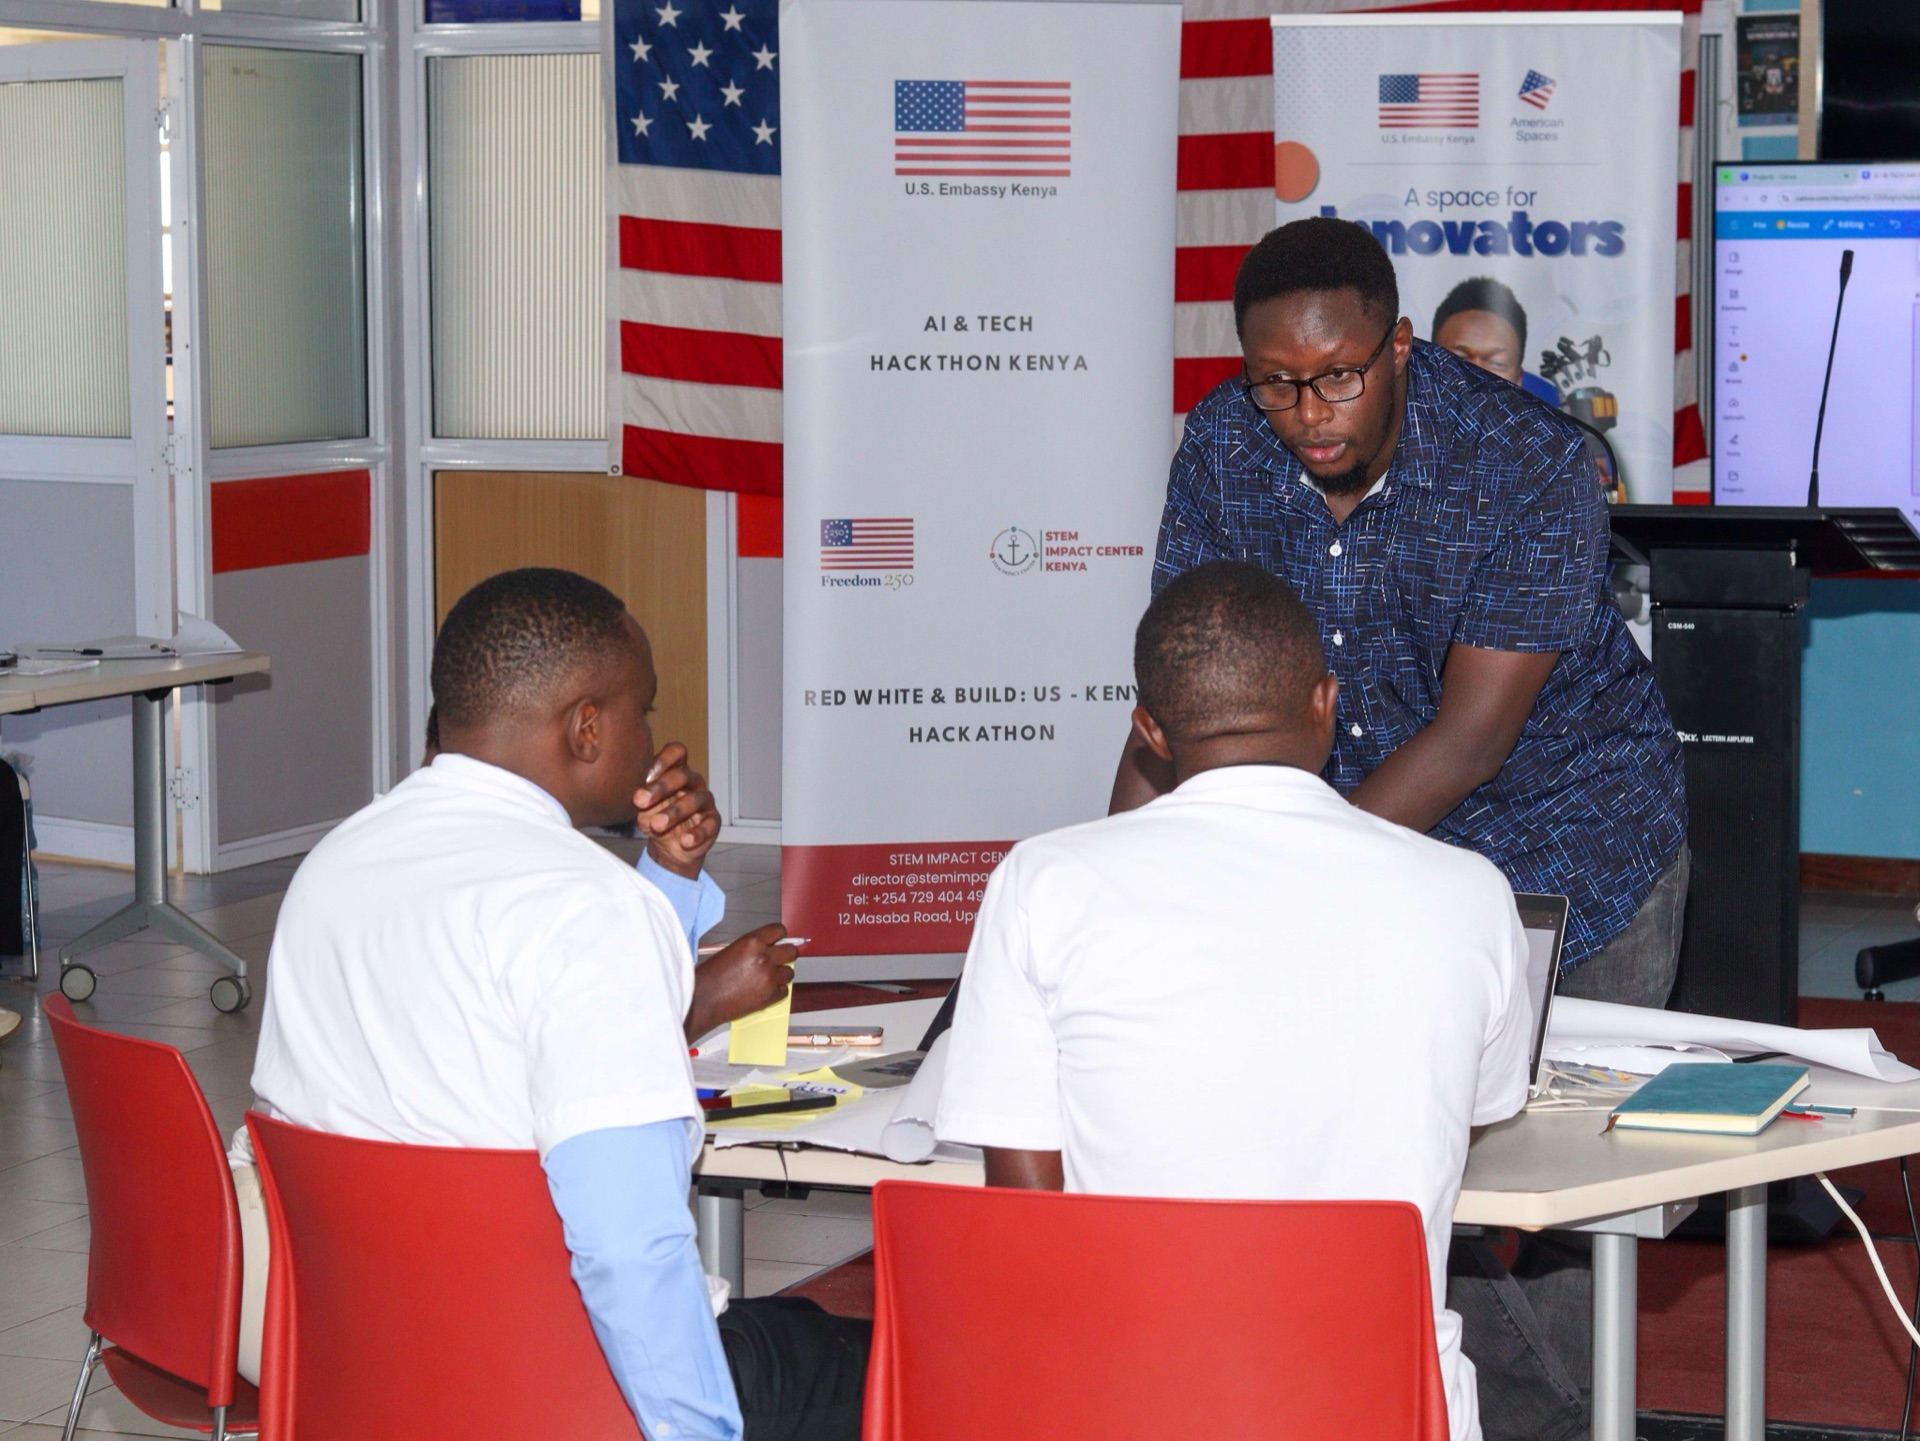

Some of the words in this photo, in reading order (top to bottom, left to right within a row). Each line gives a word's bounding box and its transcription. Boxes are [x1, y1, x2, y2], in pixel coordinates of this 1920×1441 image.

[1510, 116, 1565, 129] American
[1447, 134, 1476, 146] Kenya
[1516, 130, 1559, 143] Spaces
[904, 183, 934, 195] U.S.
[939, 183, 1006, 199] Embassy
[1011, 183, 1058, 199] Kenya
[1404, 187, 1420, 207] A
[1426, 189, 1499, 212] space
[1506, 187, 1537, 207] for
[1320, 205, 1626, 258] novators
[924, 316, 947, 331] AI
[953, 316, 969, 332] &
[977, 316, 1033, 331] TECH
[871, 355, 1000, 371] HACKTHON
[1009, 354, 1088, 371] KENYA
[830, 530, 845, 538] 250
[1045, 531, 1079, 541] STEM
[1045, 546, 1093, 557] IMPACT
[1096, 546, 1144, 556] CENTER
[1045, 562, 1088, 571] KENYA
[821, 574, 882, 587] Freedom
[884, 573, 914, 591] 250
[804, 690, 847, 706] RED
[853, 688, 924, 706] WHITE
[931, 688, 946, 704] &
[955, 687, 1026, 704] BUILD:
[1033, 686, 1061, 702] US
[1085, 685, 1138, 702] KENY
[909, 725, 1055, 743] HACKATHON
[889, 854, 923, 866] STEM
[927, 852, 977, 865] IMPACT
[980, 851, 1008, 864] CEN
[851, 871, 989, 887] director@stemimpa
[847, 894, 869, 905] Tel:
[873, 892, 907, 904] +254
[910, 891, 934, 903] 729
[938, 891, 963, 903] 404
[967, 890, 984, 902] 49
[838, 913, 850, 925] 12
[854, 912, 910, 925] Masaba
[914, 911, 952, 924] Road,
[955, 909, 978, 925] Up
